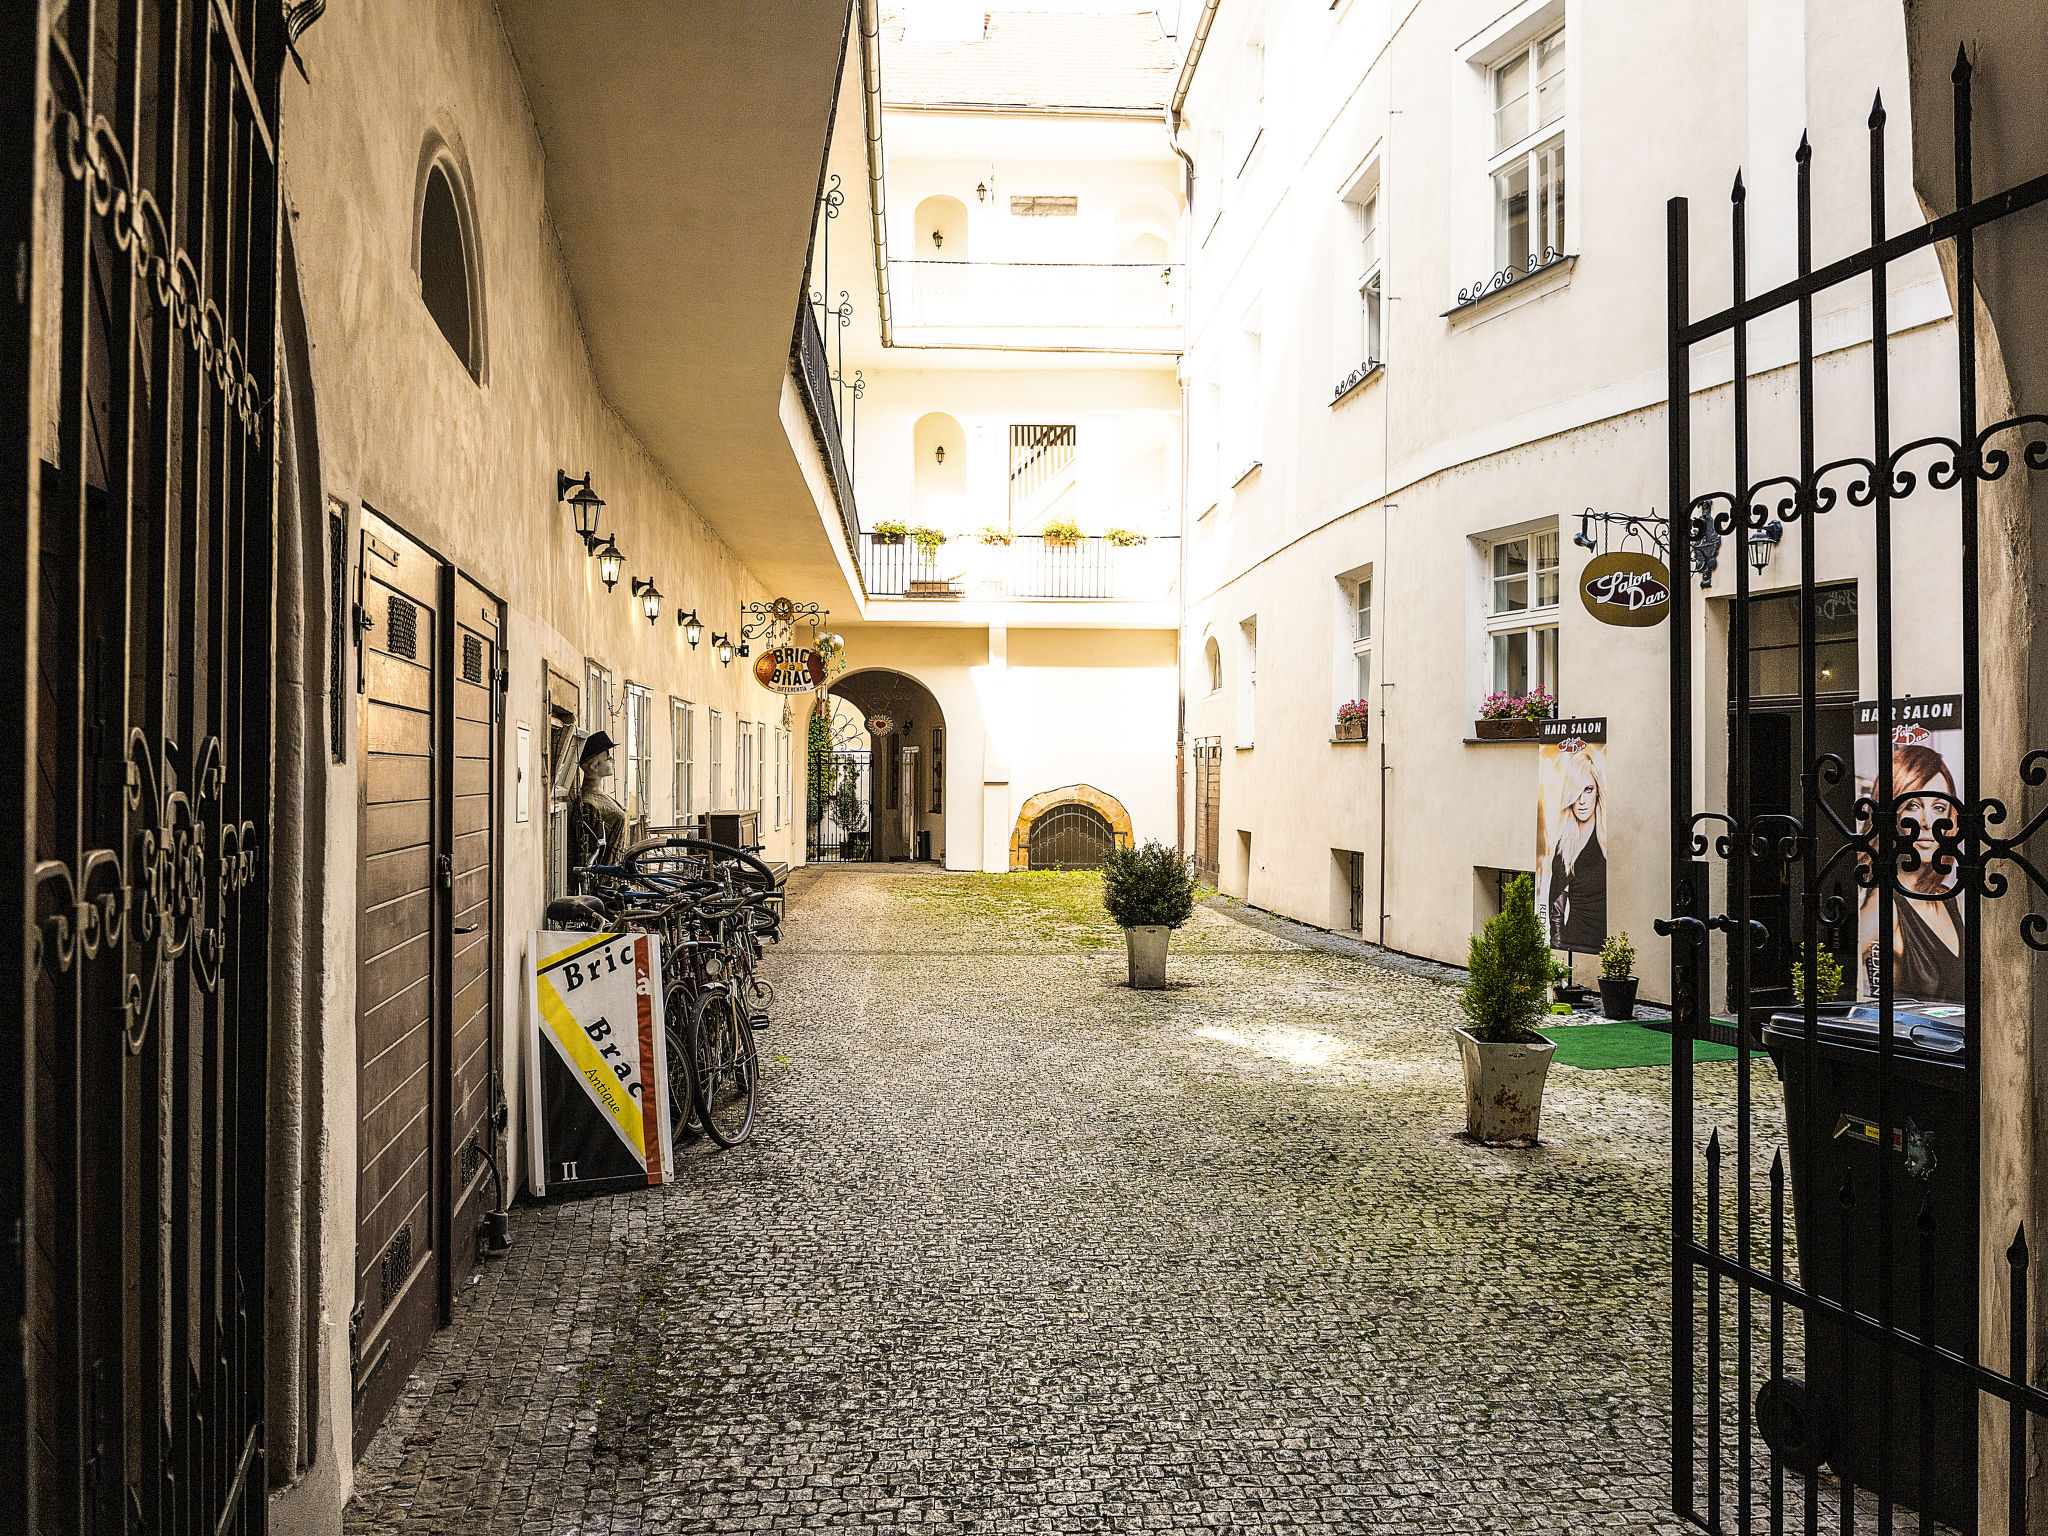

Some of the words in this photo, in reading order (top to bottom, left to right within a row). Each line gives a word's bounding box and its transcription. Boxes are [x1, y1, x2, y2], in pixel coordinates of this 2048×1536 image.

[1596, 571, 1653, 604] Salon
[1626, 586, 1666, 611] Dan
[773, 647, 810, 664] BRIC
[770, 669, 812, 685] BRAC
[1861, 707, 1897, 722] HAR
[1902, 703, 1953, 720] SALON
[1544, 723, 1567, 735] HAIR
[1570, 721, 1602, 734] SALON
[1904, 731, 1929, 746] Dan
[562, 945, 635, 993] Bric
[635, 968, 651, 996] à
[583, 1016, 646, 1099] Brac
[583, 1067, 621, 1114] Antique
